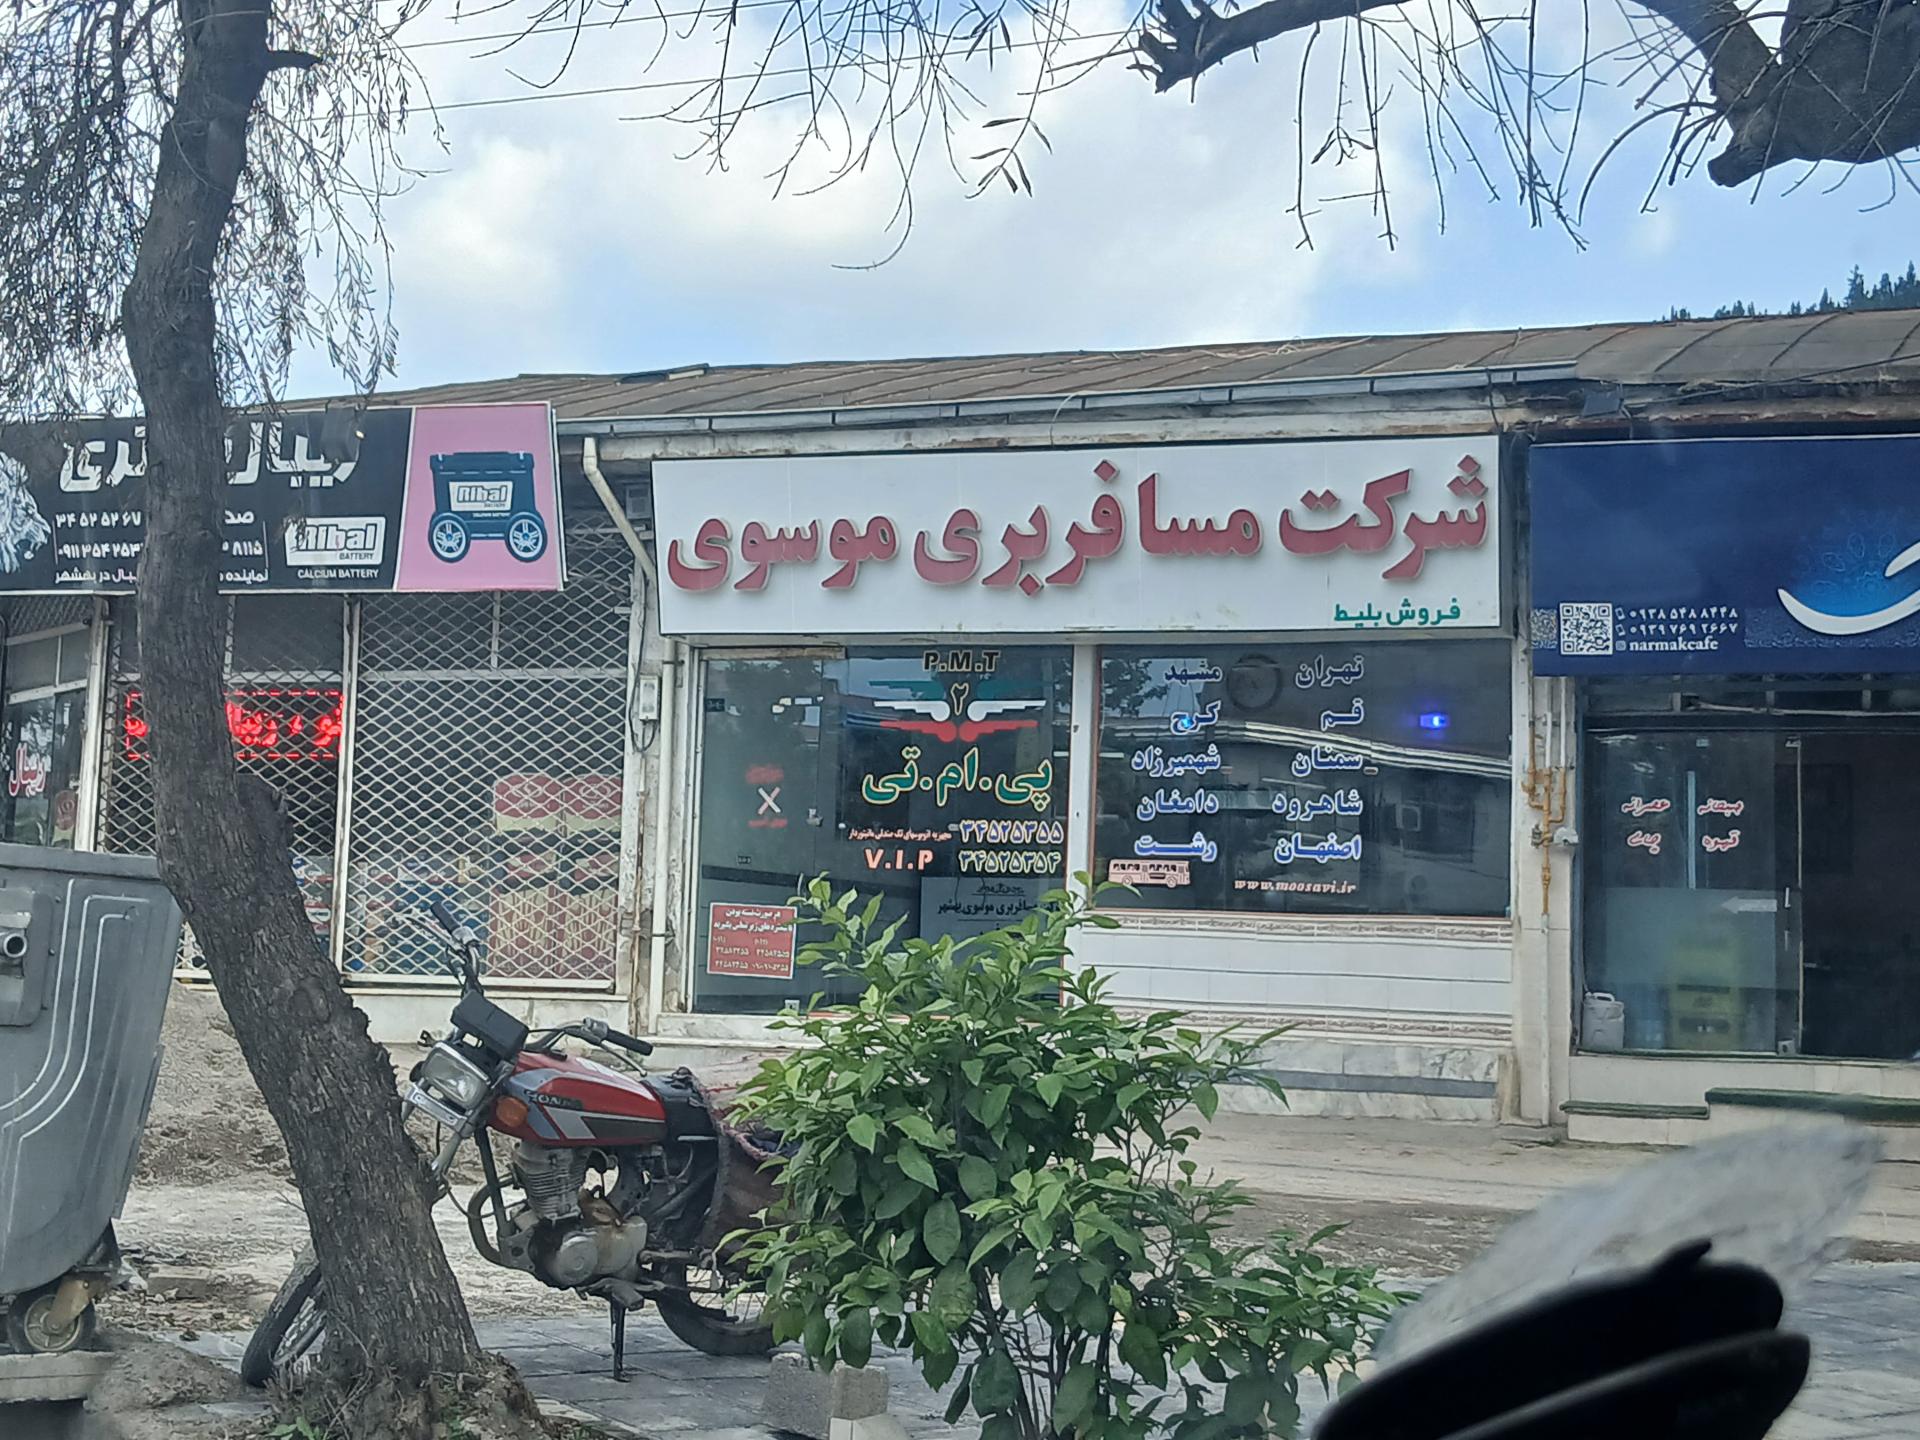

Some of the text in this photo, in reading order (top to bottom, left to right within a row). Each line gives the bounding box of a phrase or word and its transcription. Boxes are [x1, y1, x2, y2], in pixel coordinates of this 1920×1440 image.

[667, 454, 1488, 597] شرکت مسافربری موسوی
[55, 566, 98, 584] بهشهر
[225, 568, 269, 585] نماینده
[297, 568, 379, 580] CALCIUM BATTERY
[1334, 598, 1461, 628] فروش بلیط
[1629, 636, 1719, 651] narmakcafe
[1164, 658, 1223, 685] مشهد
[1296, 654, 1365, 688] تهران
[1170, 701, 1221, 735] کرج
[1320, 698, 1365, 732] قم
[1131, 743, 1221, 777] شهمیرزاد
[1291, 744, 1363, 777] سمنان
[1137, 788, 1219, 821] دامغان
[1272, 788, 1363, 821] شاهرود
[959, 819, 1065, 844] ۳۴۵۲۵۳۵۵
[958, 850, 1062, 874] ۳۴۵۲۵۳۵۴
[1134, 832, 1218, 862] رشت
[1274, 832, 1362, 864] اصفهان
[1234, 878, 1356, 894] www.moosavi.ir
